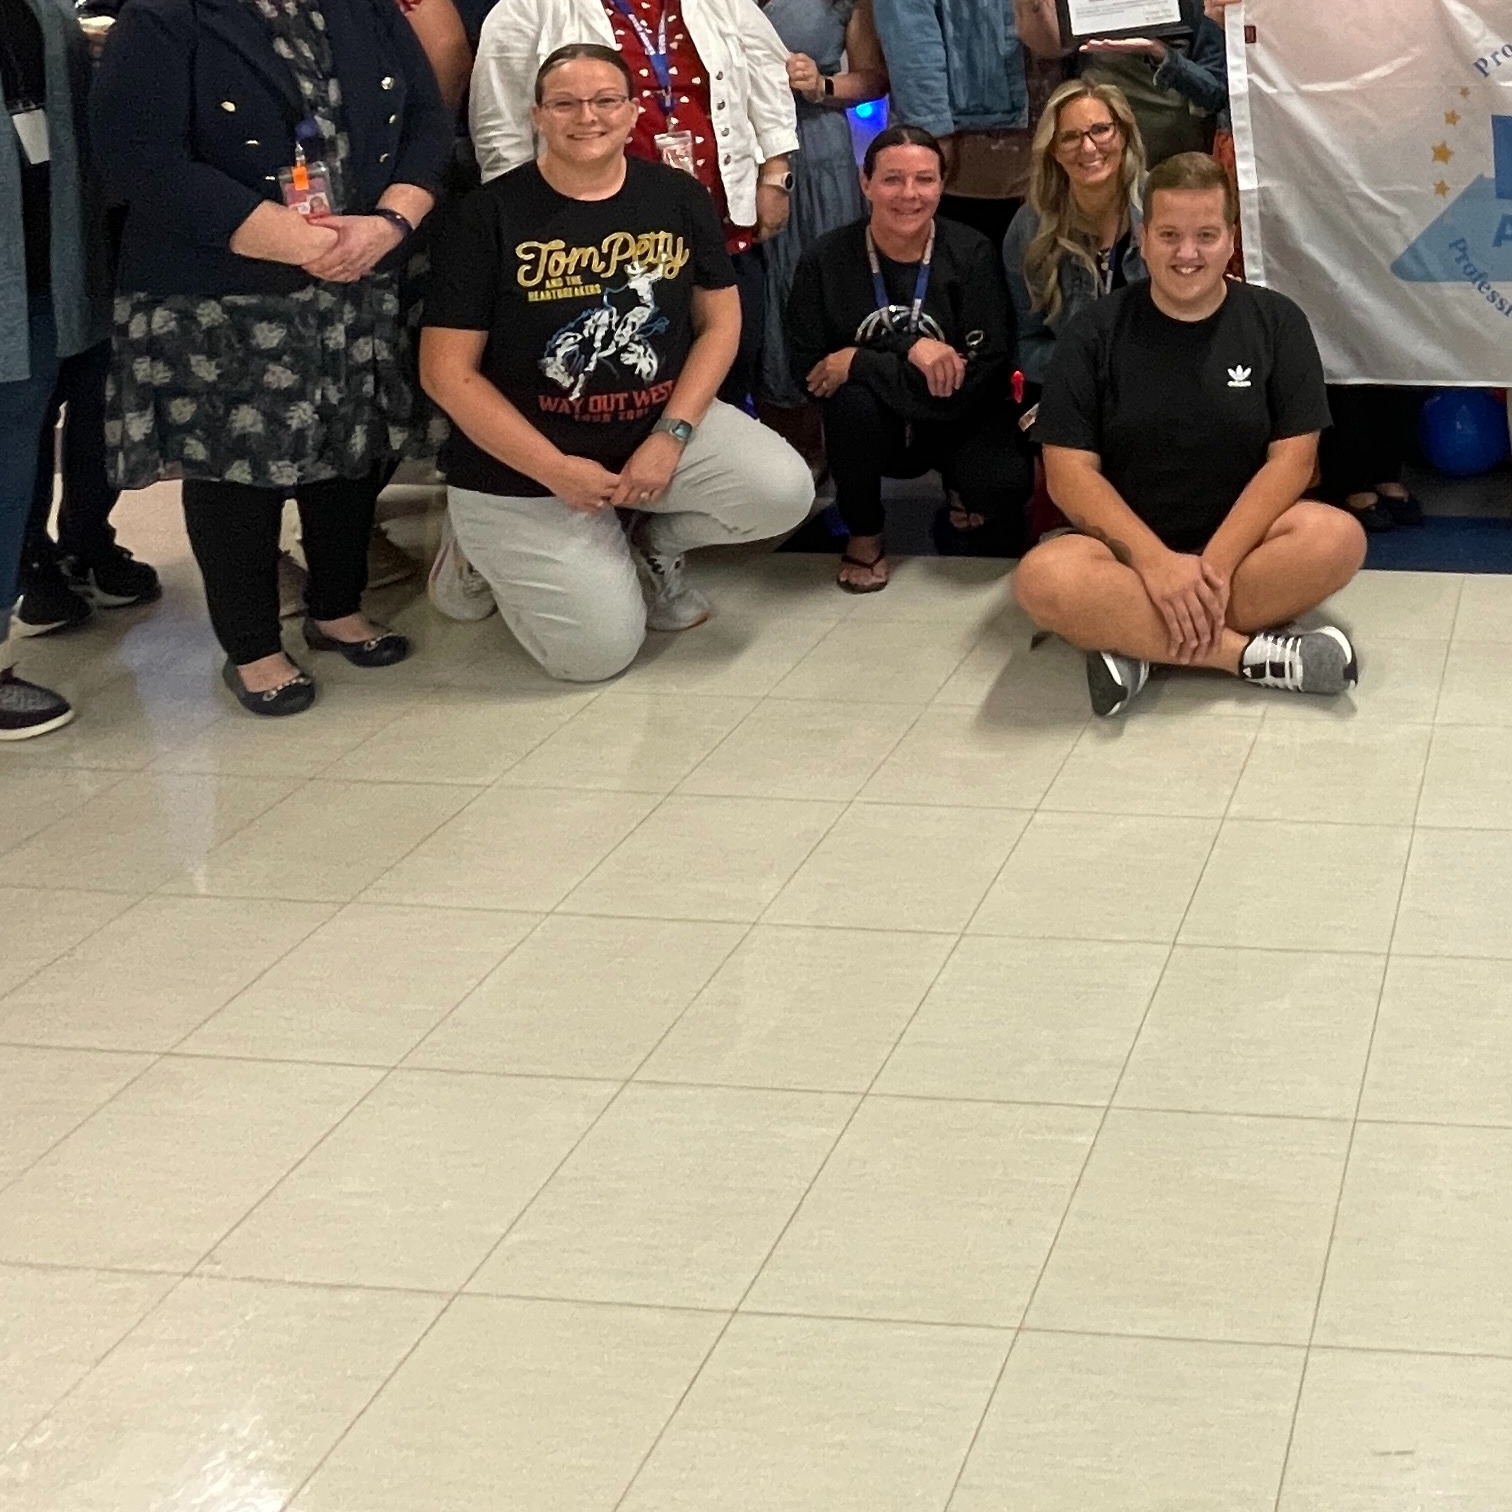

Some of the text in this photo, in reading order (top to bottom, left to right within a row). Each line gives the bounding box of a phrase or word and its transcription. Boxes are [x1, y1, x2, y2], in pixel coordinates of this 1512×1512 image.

[515, 230, 690, 287] Tom Petty
[545, 275, 583, 288] AND THE
[538, 394, 584, 414] WAY
[589, 393, 629, 413] OUT
